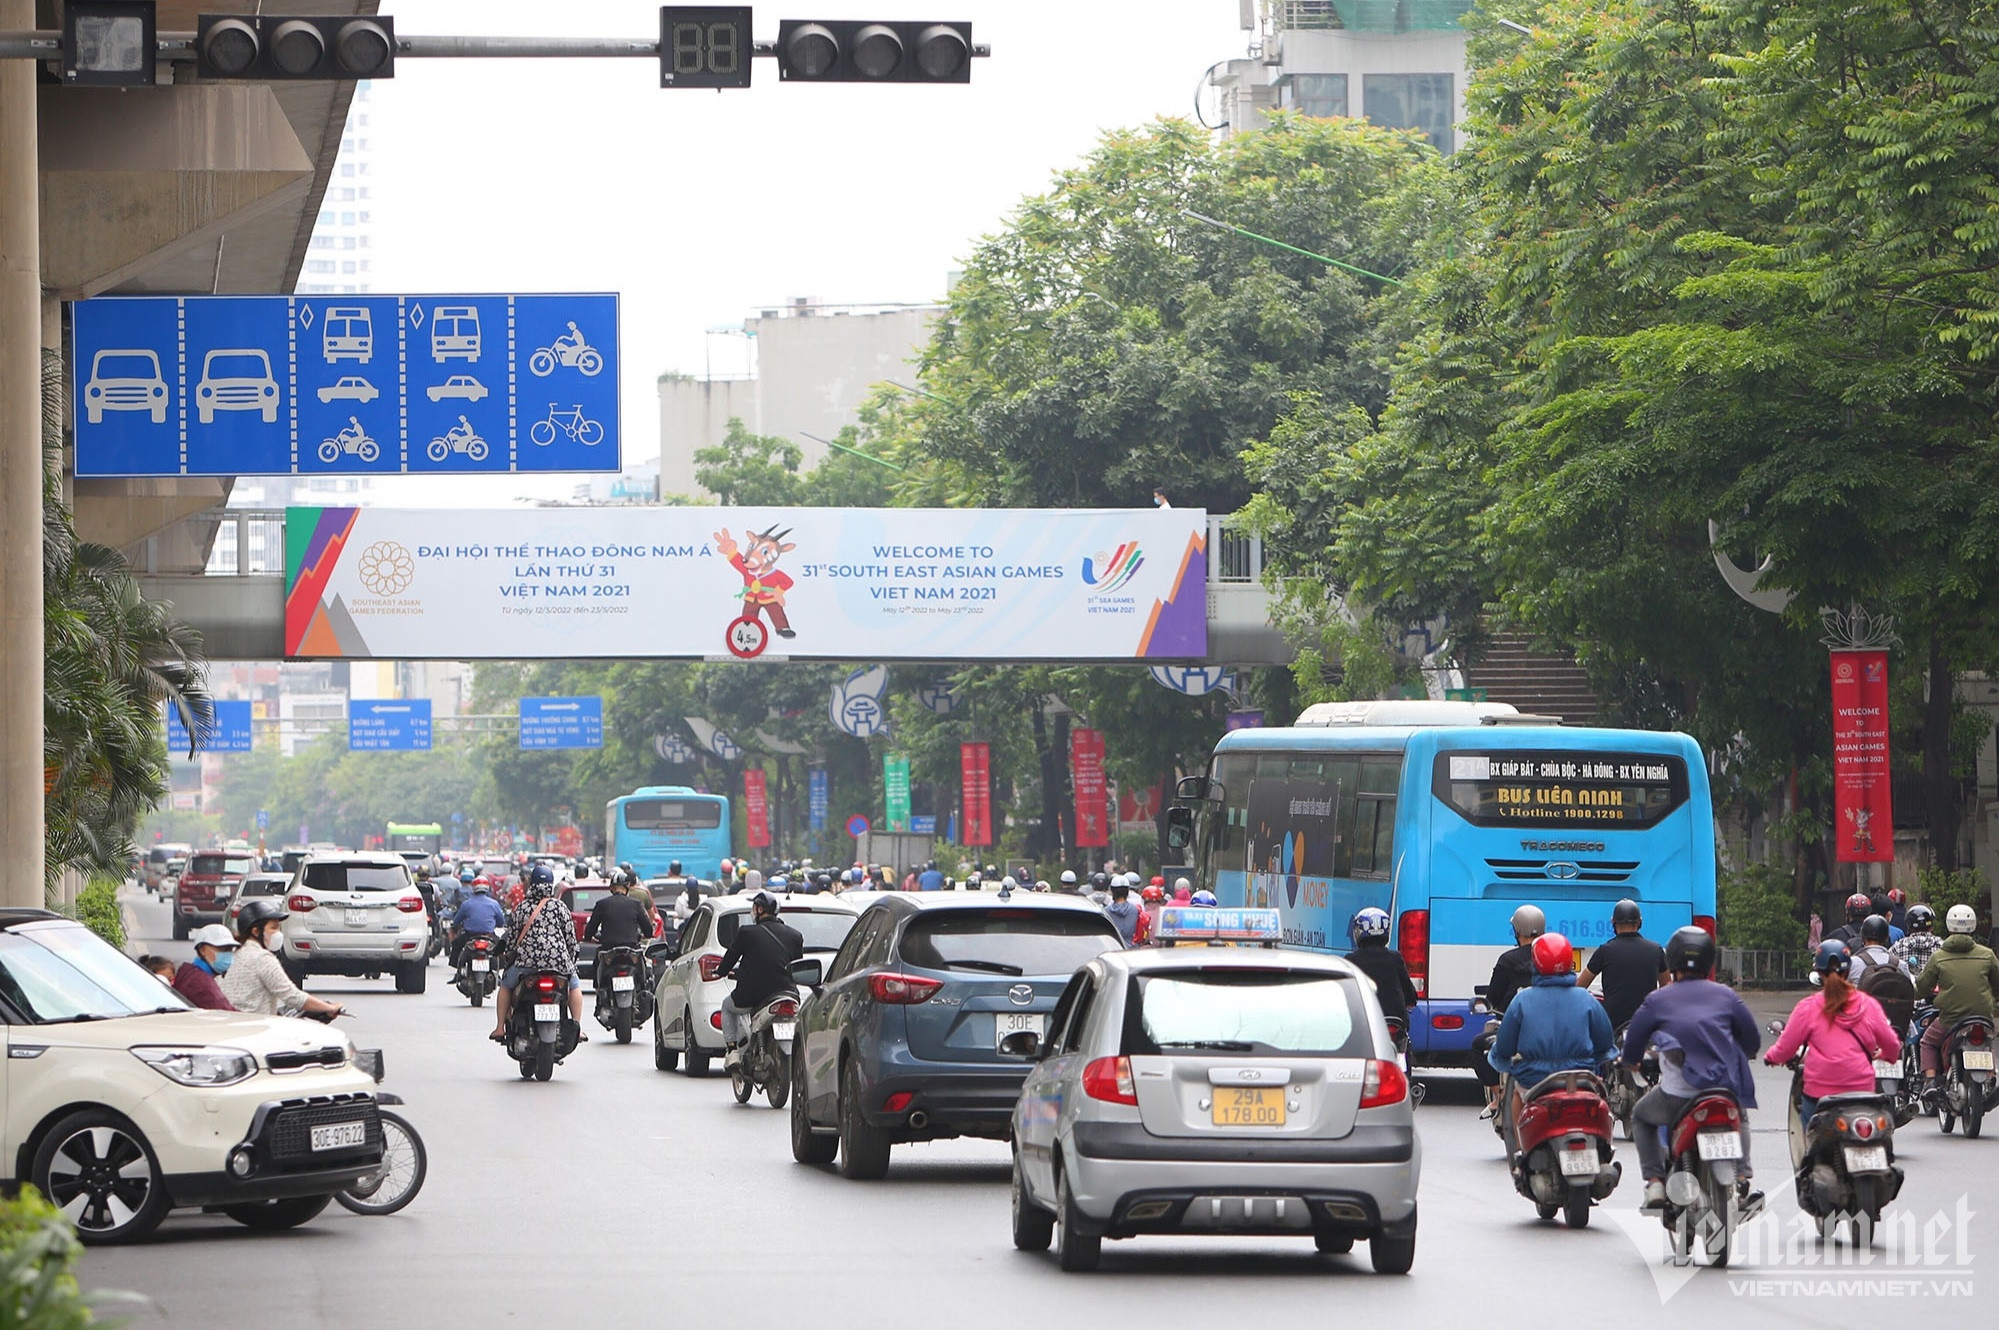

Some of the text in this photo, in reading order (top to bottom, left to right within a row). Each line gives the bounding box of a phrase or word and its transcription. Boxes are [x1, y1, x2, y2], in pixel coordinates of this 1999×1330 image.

[418, 545, 449, 560] ĐẠI
[456, 543, 488, 560] HỘI
[535, 546, 585, 558] THAO
[592, 543, 646, 557] ĐÔNG
[652, 546, 694, 557] NAM
[699, 542, 712, 557] Á
[873, 546, 994, 558] WELCOME TO
[556, 562, 594, 577] THỨ
[599, 566, 615, 577] 31
[828, 565, 888, 578] SOUTH
[894, 566, 938, 578] EAST
[942, 566, 996, 578] ASIAN
[1002, 566, 1064, 578] GAMES
[499, 582, 630, 600] VIỆT NAM 2021
[870, 587, 996, 600] VIET NAM 2021
[352, 599, 421, 607] SOUTHEAST ASIAN
[349, 607, 424, 615] GAMES FEDERATION
[1838, 707, 1880, 716] WELCOME
[1869, 755, 1884, 763] 2021
[1490, 762, 1500, 776] BX
[1502, 760, 1519, 776] GIÁP
[1520, 760, 1534, 776] BÁT
[1541, 761, 1560, 777] CHÙA
[1561, 761, 1576, 780] BỘC
[1582, 761, 1593, 778] HÀ
[1594, 762, 1614, 778] ĐÔNG
[1620, 765, 1630, 779] BX
[1631, 763, 1645, 780] YÊN
[1646, 764, 1669, 780] NGHĨA
[1498, 785, 1623, 806] BUS LIÊN NINH
[1510, 807, 1624, 819] Hotline 1900.1298
[1521, 840, 1606, 852] TRACOMECO
[1303, 881, 1329, 908] MONEY
[1007, 1014, 1033, 1031] 30E
[1234, 1089, 1264, 1105] 29A
[1222, 1107, 1277, 1123] 178.00
